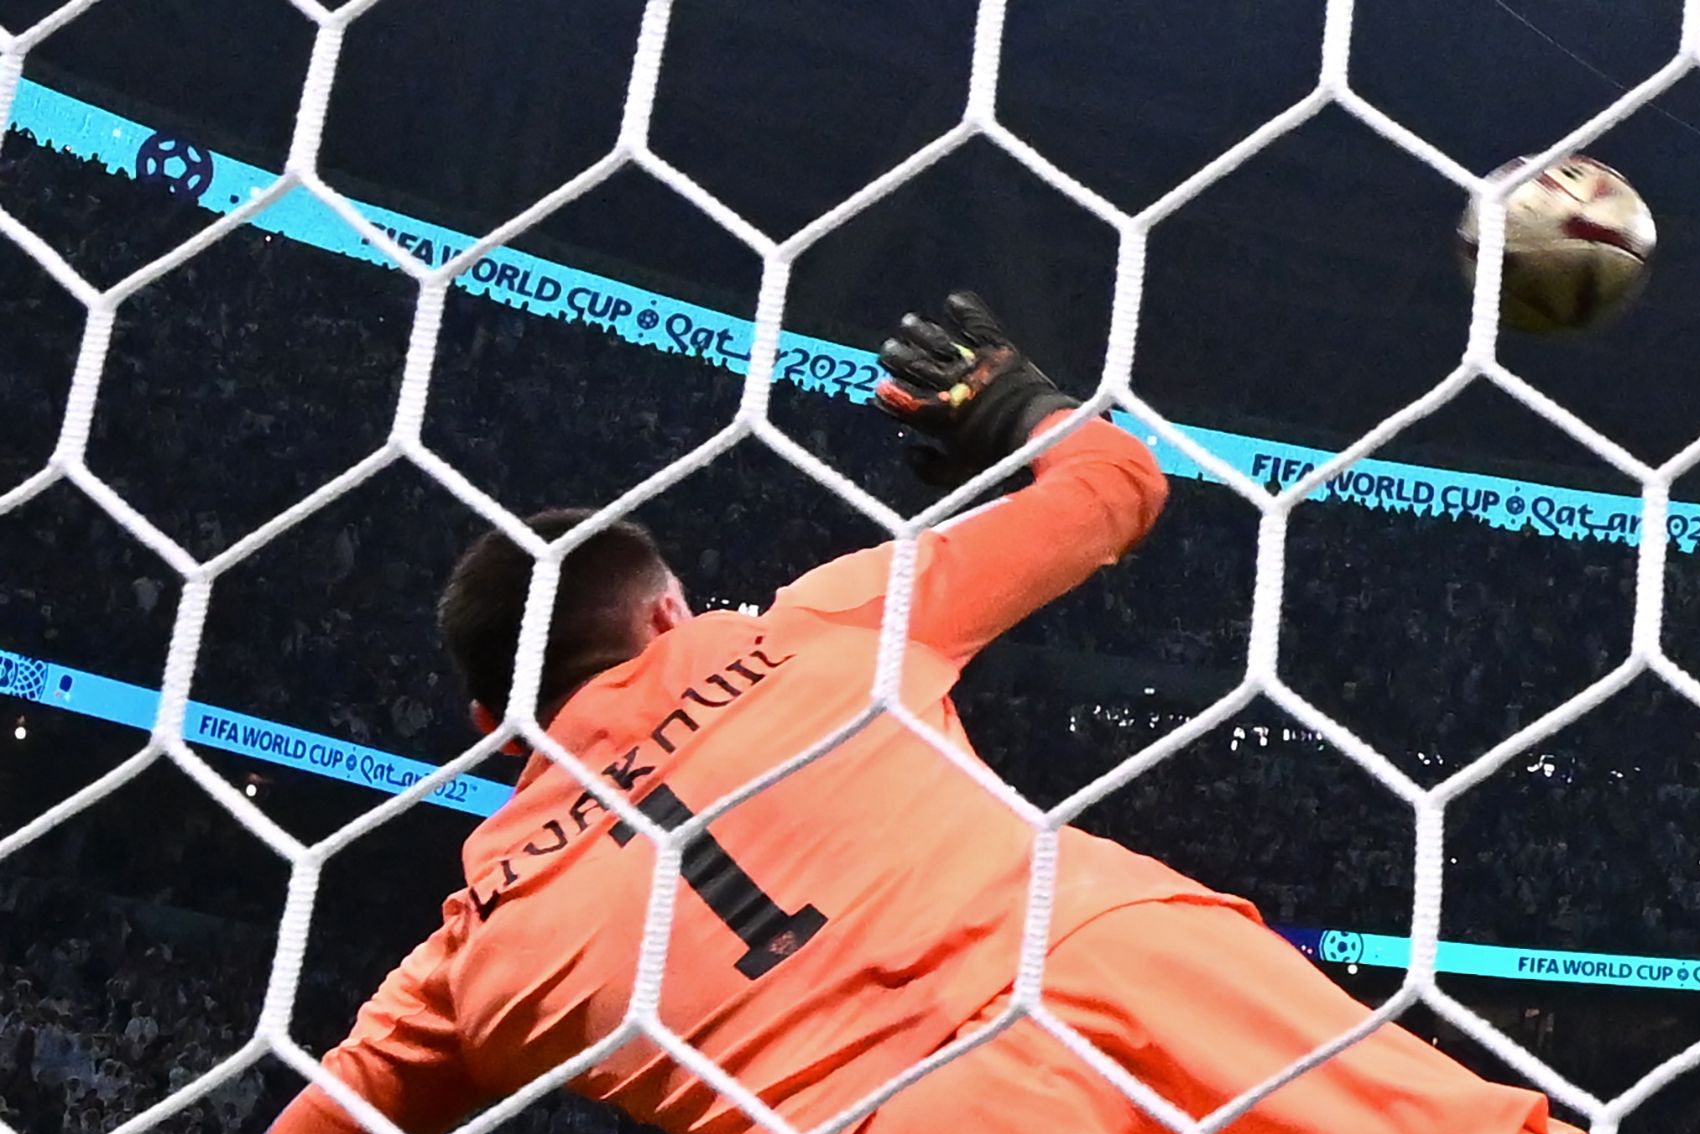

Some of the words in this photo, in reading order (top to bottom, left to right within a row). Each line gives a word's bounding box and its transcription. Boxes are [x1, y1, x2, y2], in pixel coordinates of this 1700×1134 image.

[566, 287, 632, 322] CUP
[1440, 485, 1500, 513] CUP
[199, 714, 239, 744] FIFA
[242, 725, 307, 759] WORLD
[309, 743, 344, 769] CUP
[608, 782, 829, 981] 1
[1518, 956, 1559, 974] FIFA
[1563, 959, 1632, 979] WORLD
[1636, 964, 1674, 981] CUP
